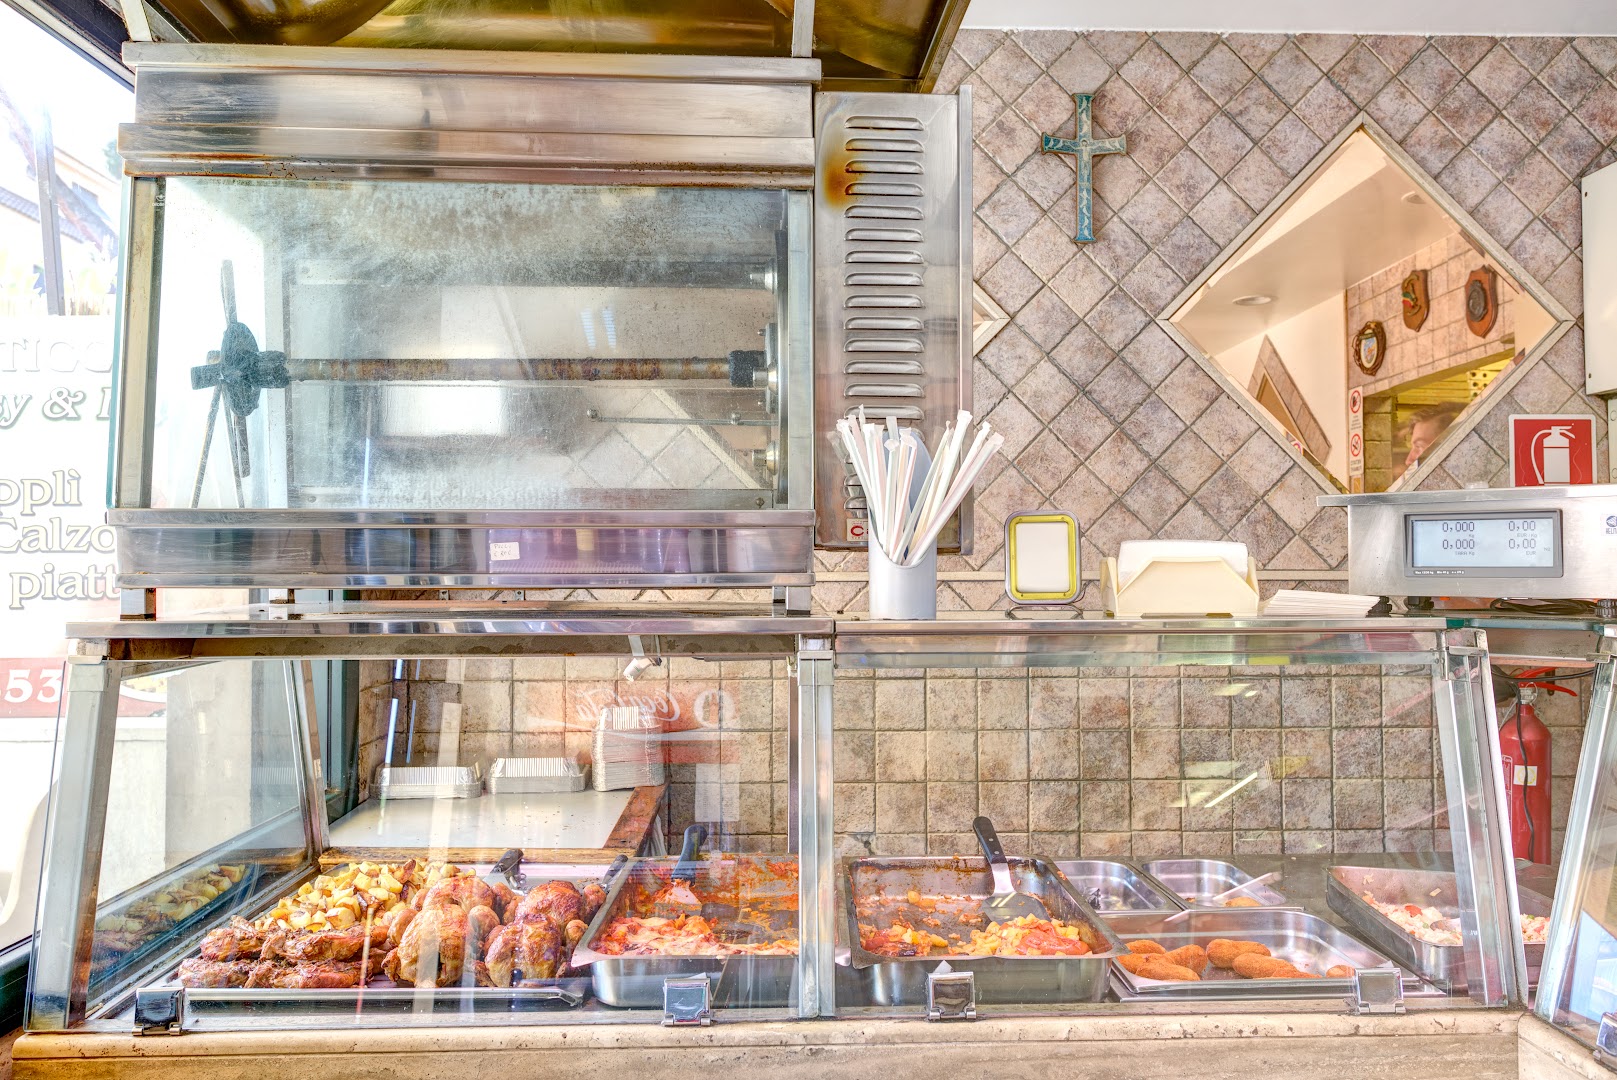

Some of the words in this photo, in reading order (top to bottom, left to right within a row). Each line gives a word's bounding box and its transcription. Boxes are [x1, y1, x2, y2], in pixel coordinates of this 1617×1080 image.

[42, 386, 87, 421] &
[1442, 521, 1475, 533] 0,000
[1508, 520, 1536, 532] 0,00
[1442, 538, 1475, 550] 0,000
[1508, 538, 1536, 549] 0,00
[9, 562, 121, 610] piatt
